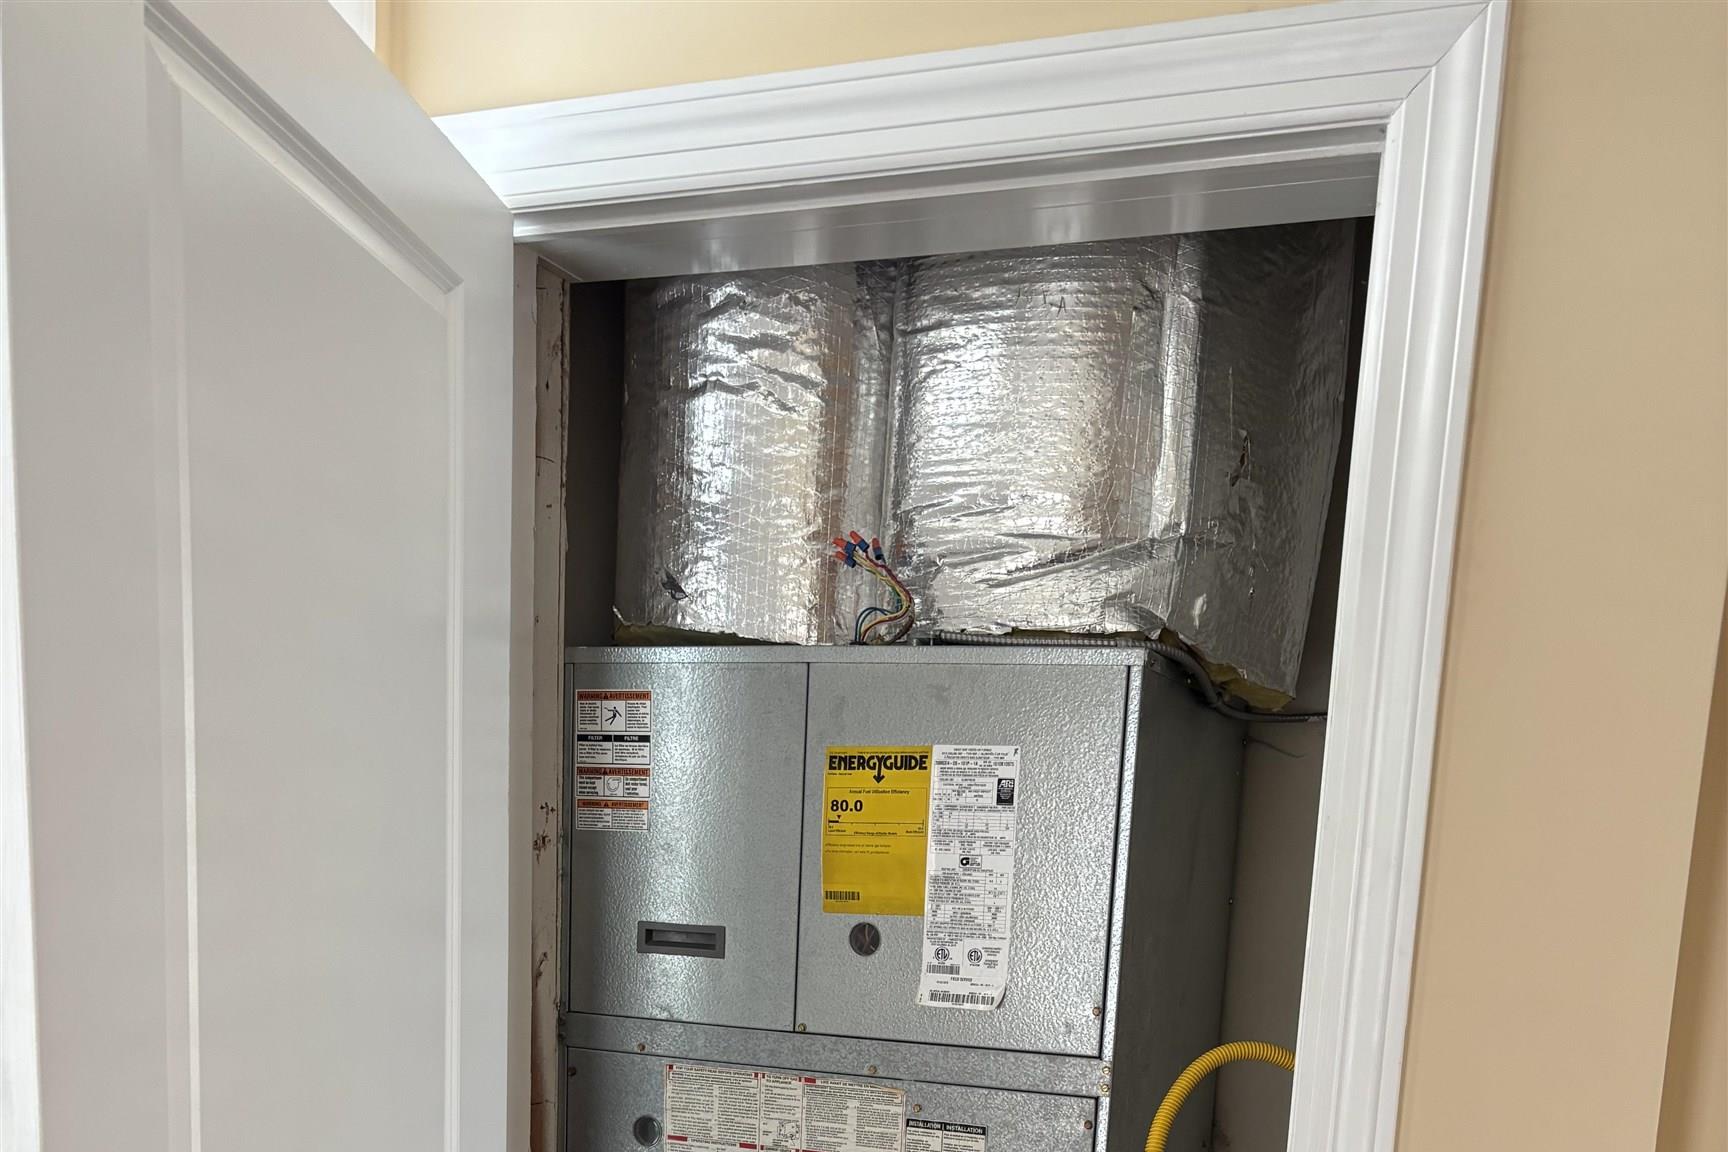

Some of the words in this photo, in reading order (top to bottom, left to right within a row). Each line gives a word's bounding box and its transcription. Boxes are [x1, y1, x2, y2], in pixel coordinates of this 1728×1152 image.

[828, 754, 929, 771] ENERGYGUIDE
[830, 799, 863, 812] 80.0
[946, 1125, 983, 1134] INSTALLATION
